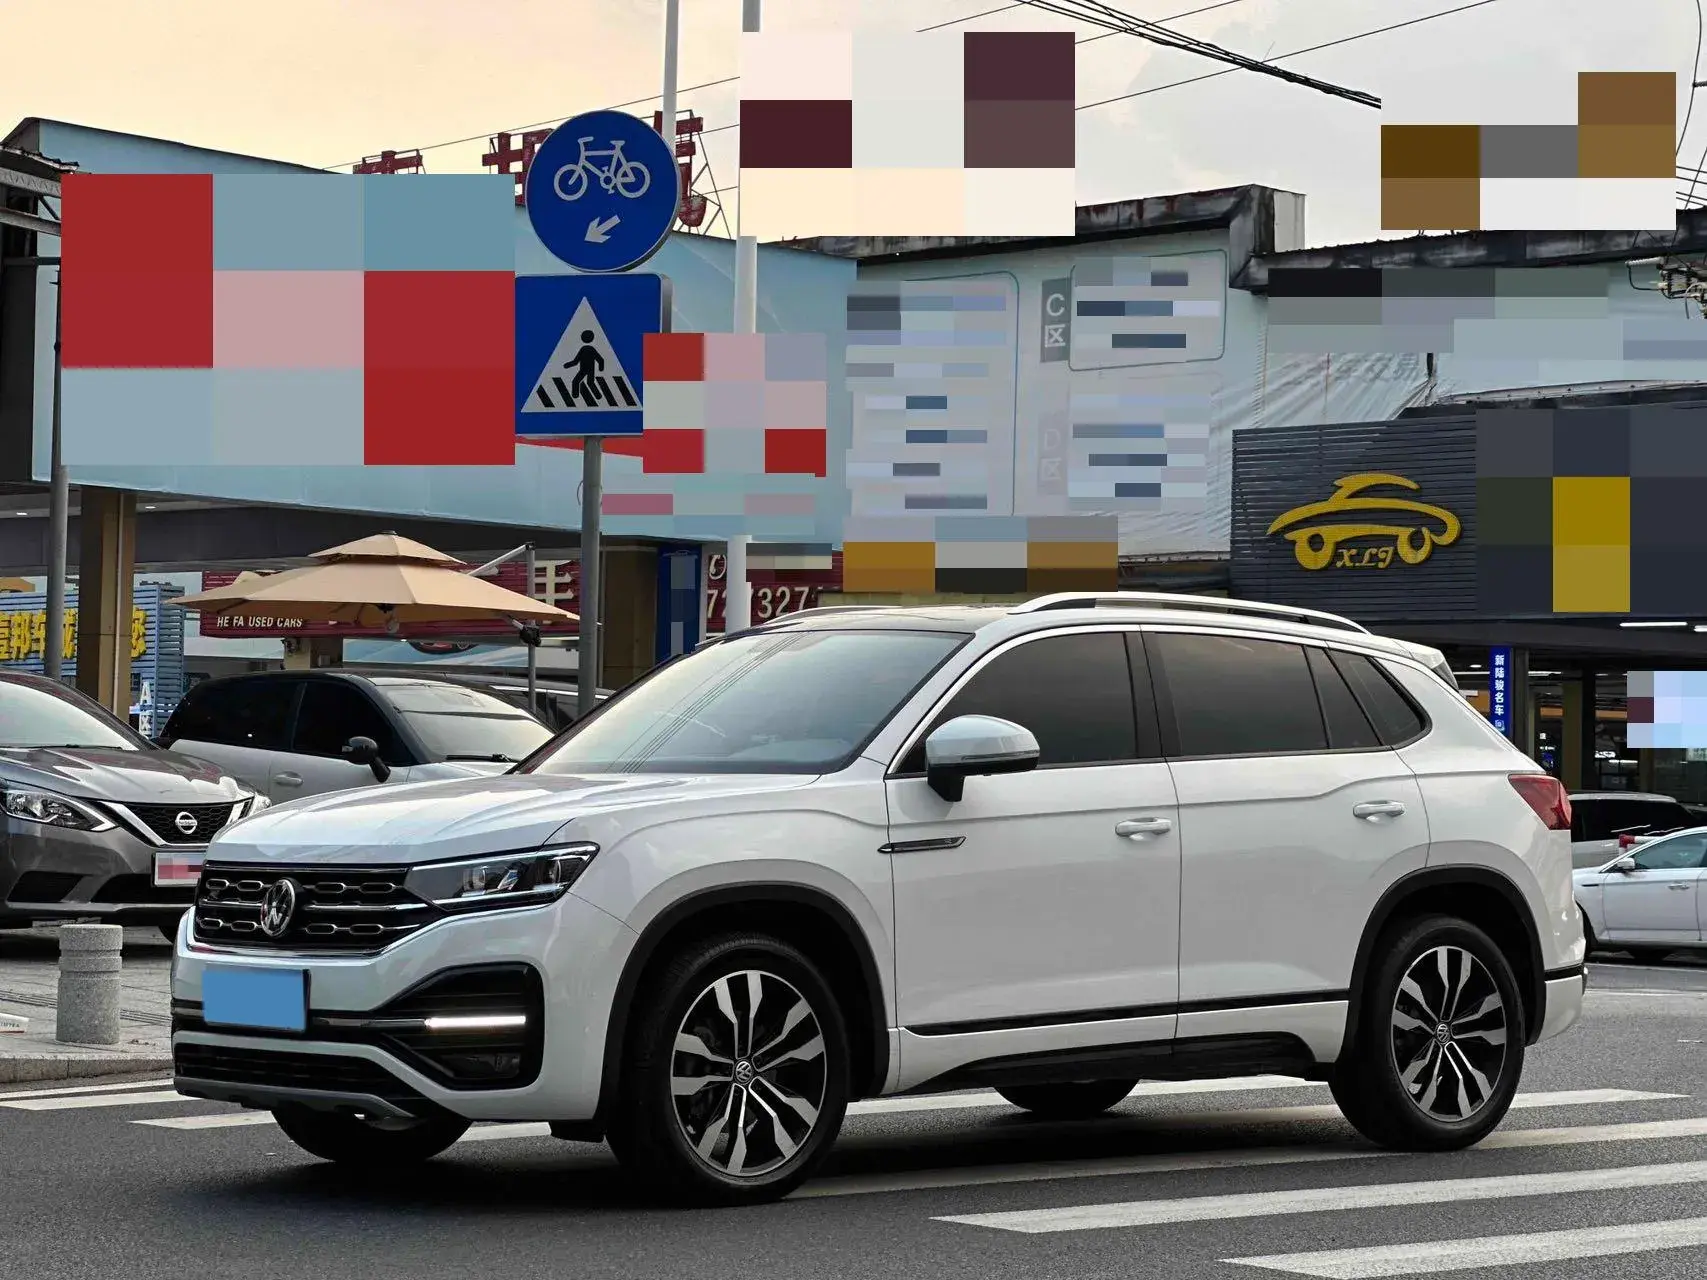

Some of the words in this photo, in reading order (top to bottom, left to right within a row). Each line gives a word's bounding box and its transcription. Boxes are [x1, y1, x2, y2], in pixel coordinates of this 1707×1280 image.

[1046, 293, 1066, 348] C区
[216, 616, 229, 628] HE
[233, 616, 244, 627] FA
[248, 616, 273, 628] USED
[277, 617, 303, 628] CARS
[1494, 654, 1505, 716] 新陆骏名车
